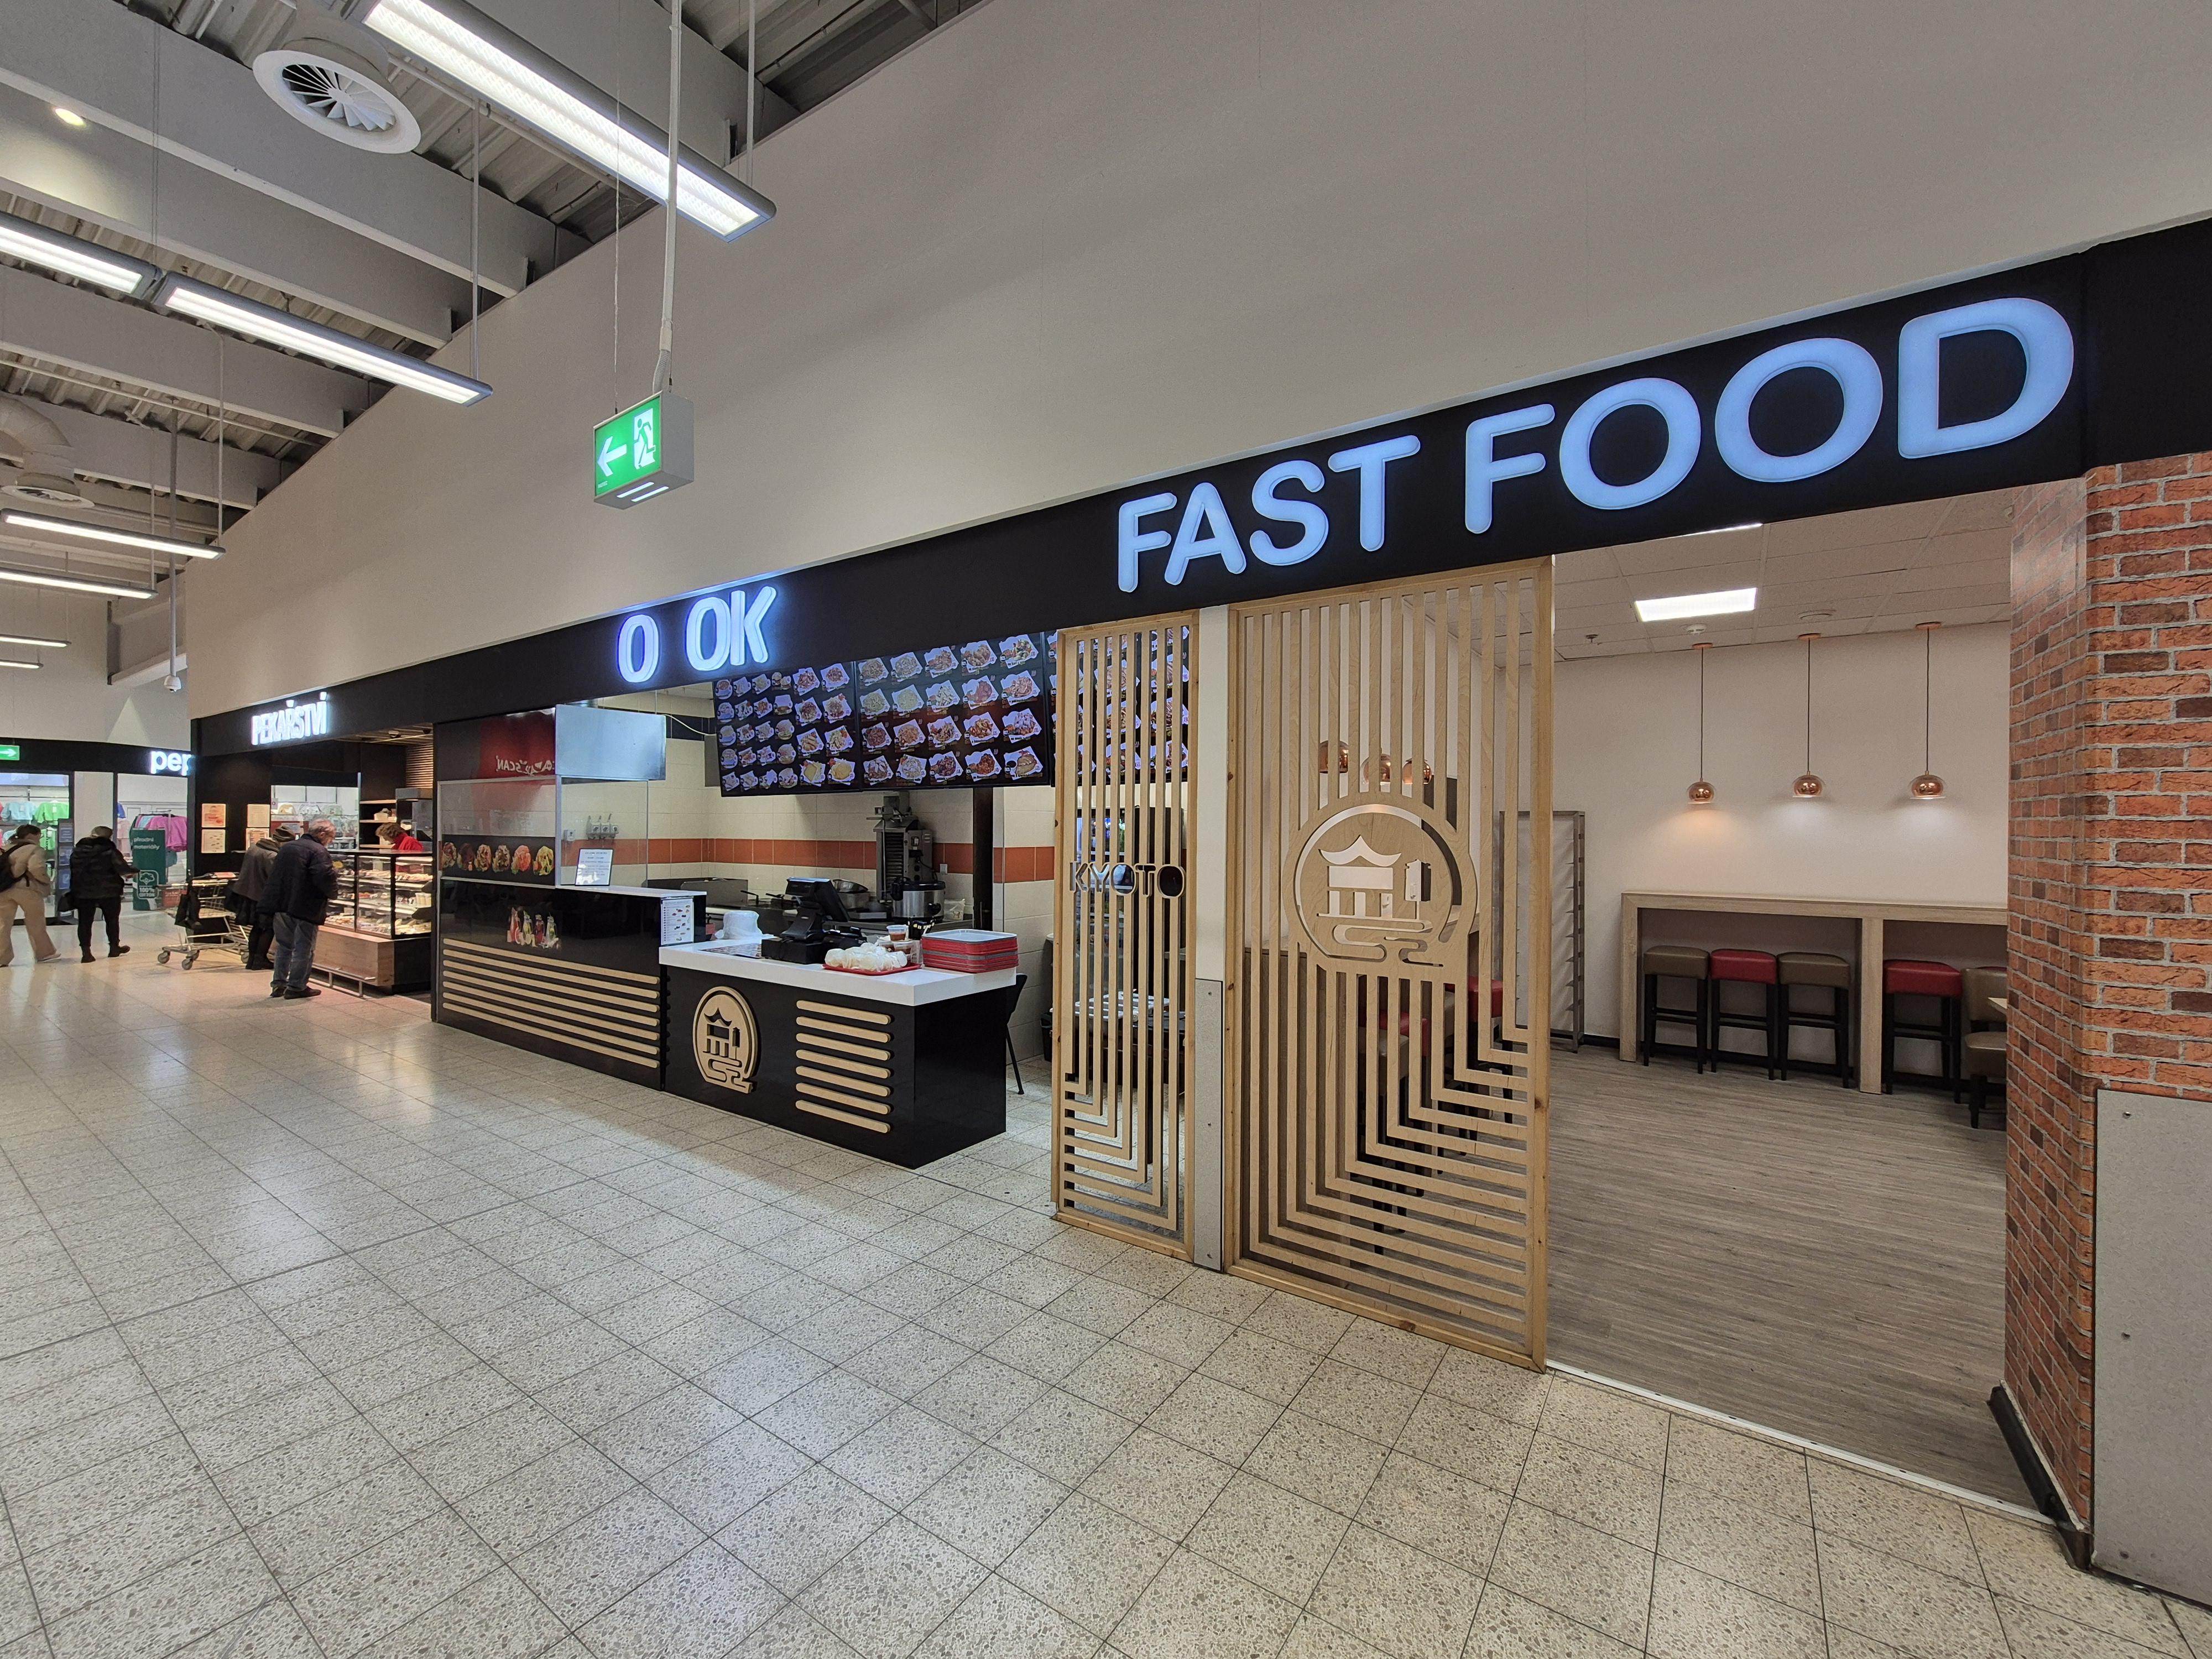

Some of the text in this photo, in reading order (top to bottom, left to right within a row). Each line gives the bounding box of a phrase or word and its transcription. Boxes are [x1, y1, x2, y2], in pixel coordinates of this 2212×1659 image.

[1117, 297, 2075, 594] FAST FOOD
[618, 586, 777, 683] O OK
[1069, 860, 1185, 898] KYOTO
